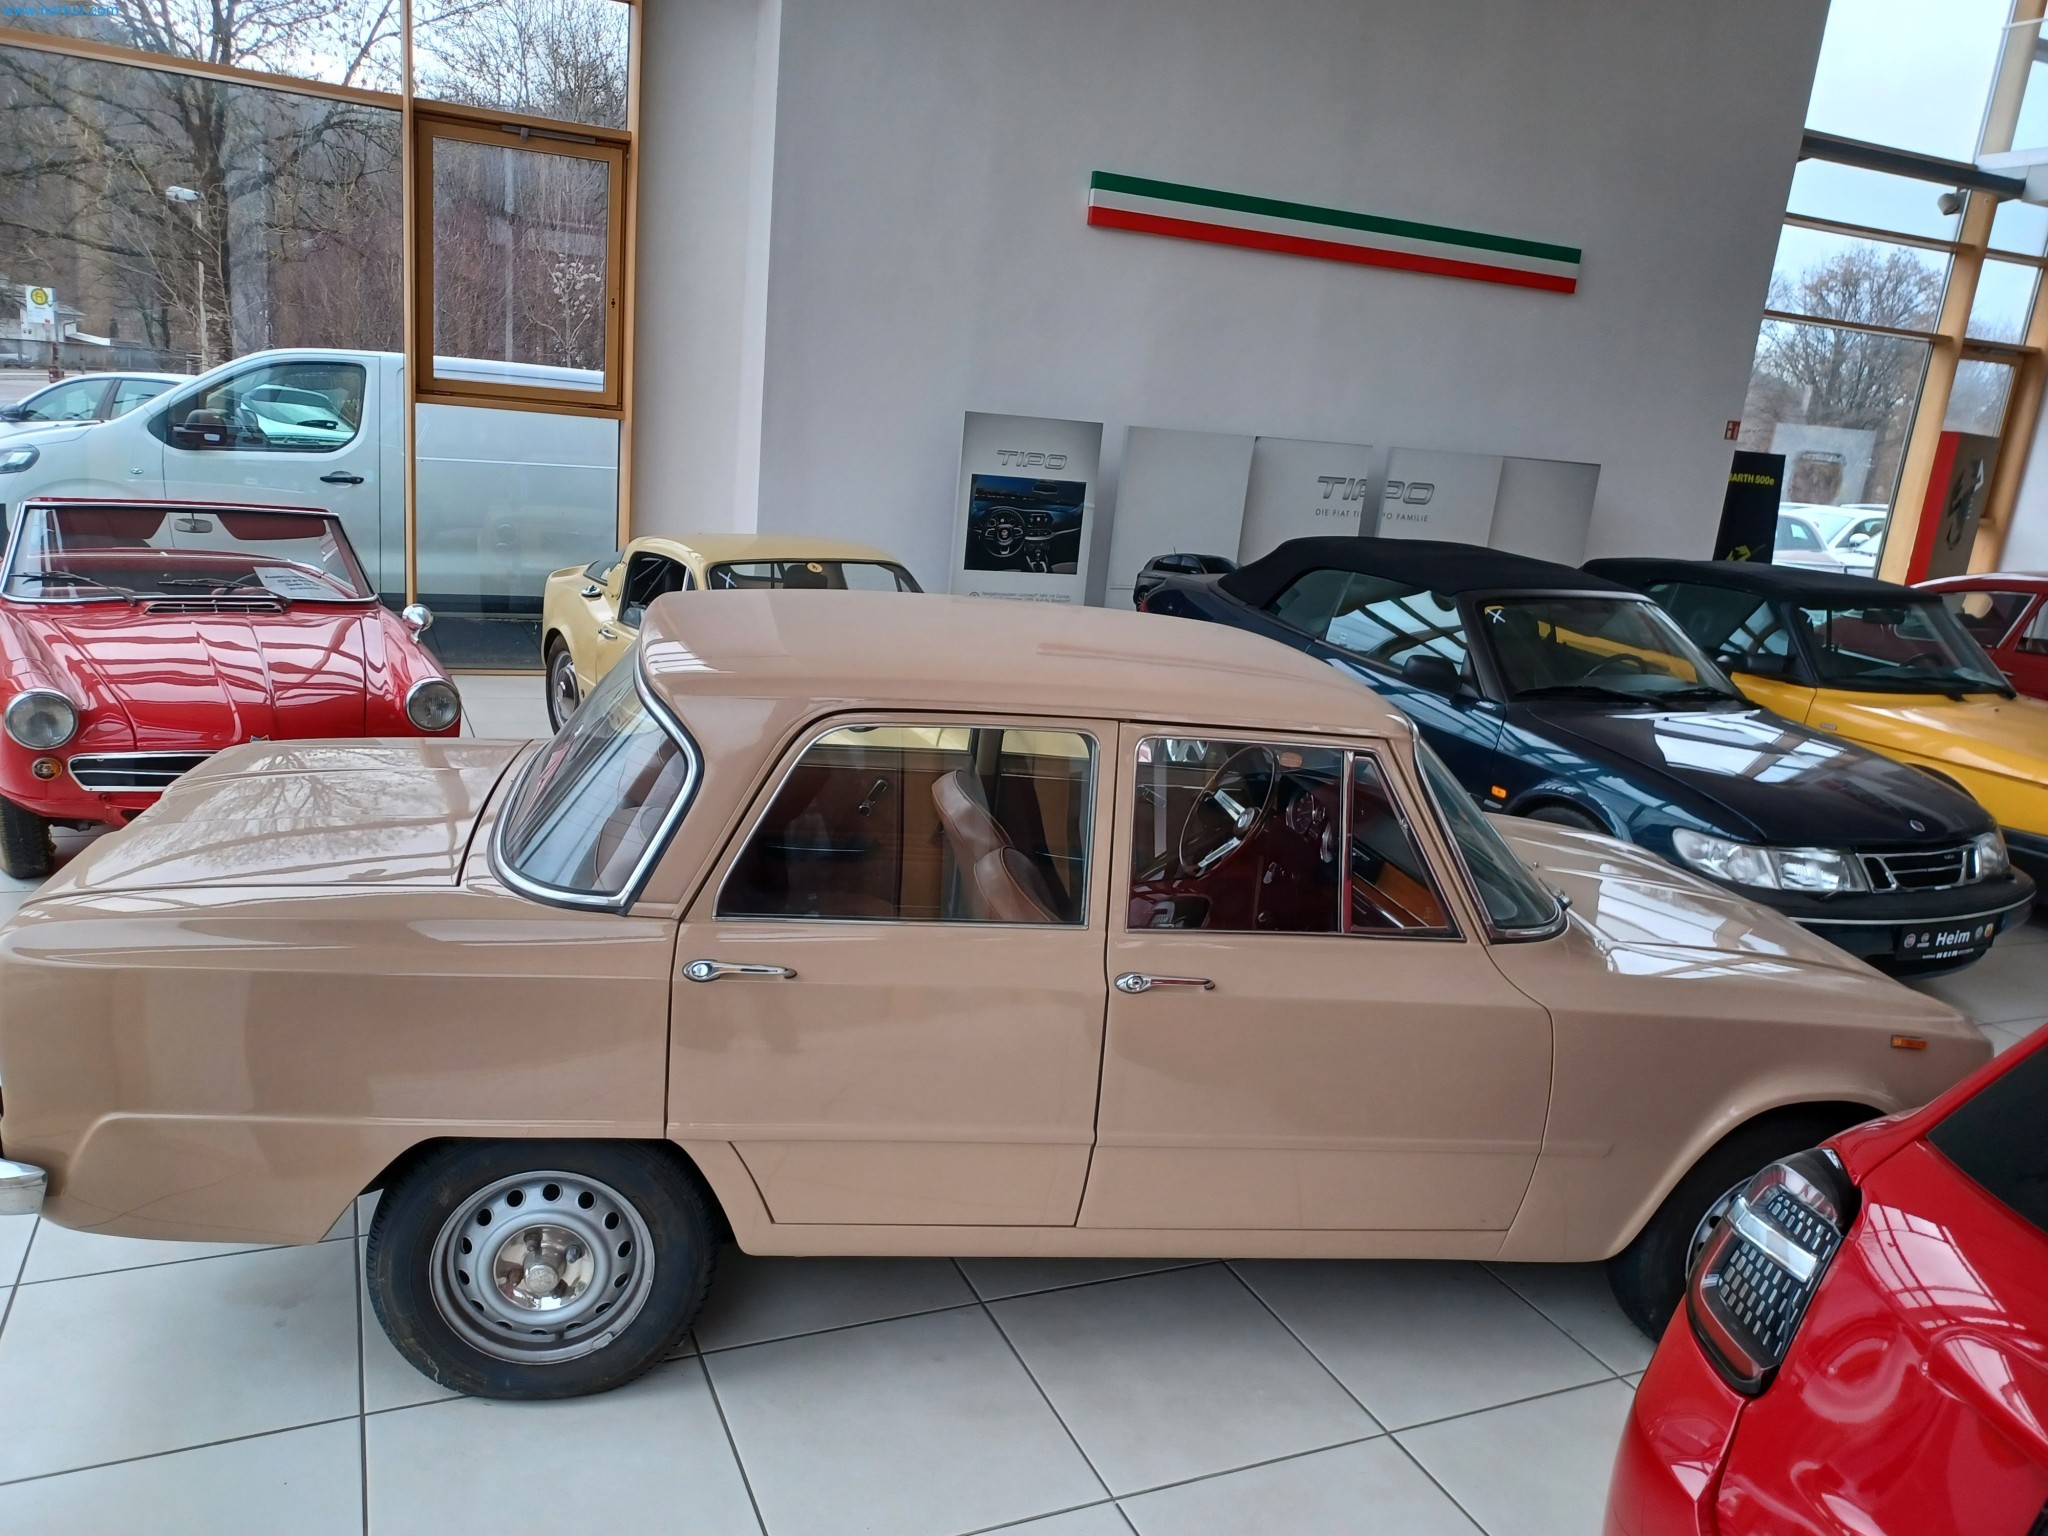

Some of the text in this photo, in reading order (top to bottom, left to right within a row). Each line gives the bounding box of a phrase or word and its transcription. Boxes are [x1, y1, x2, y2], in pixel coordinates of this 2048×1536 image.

[997, 449, 1068, 470] TIPO
[1315, 508, 1329, 516] DIE
[1332, 509, 1350, 517] FIAT
[1396, 512, 1429, 523] FAMILIE
